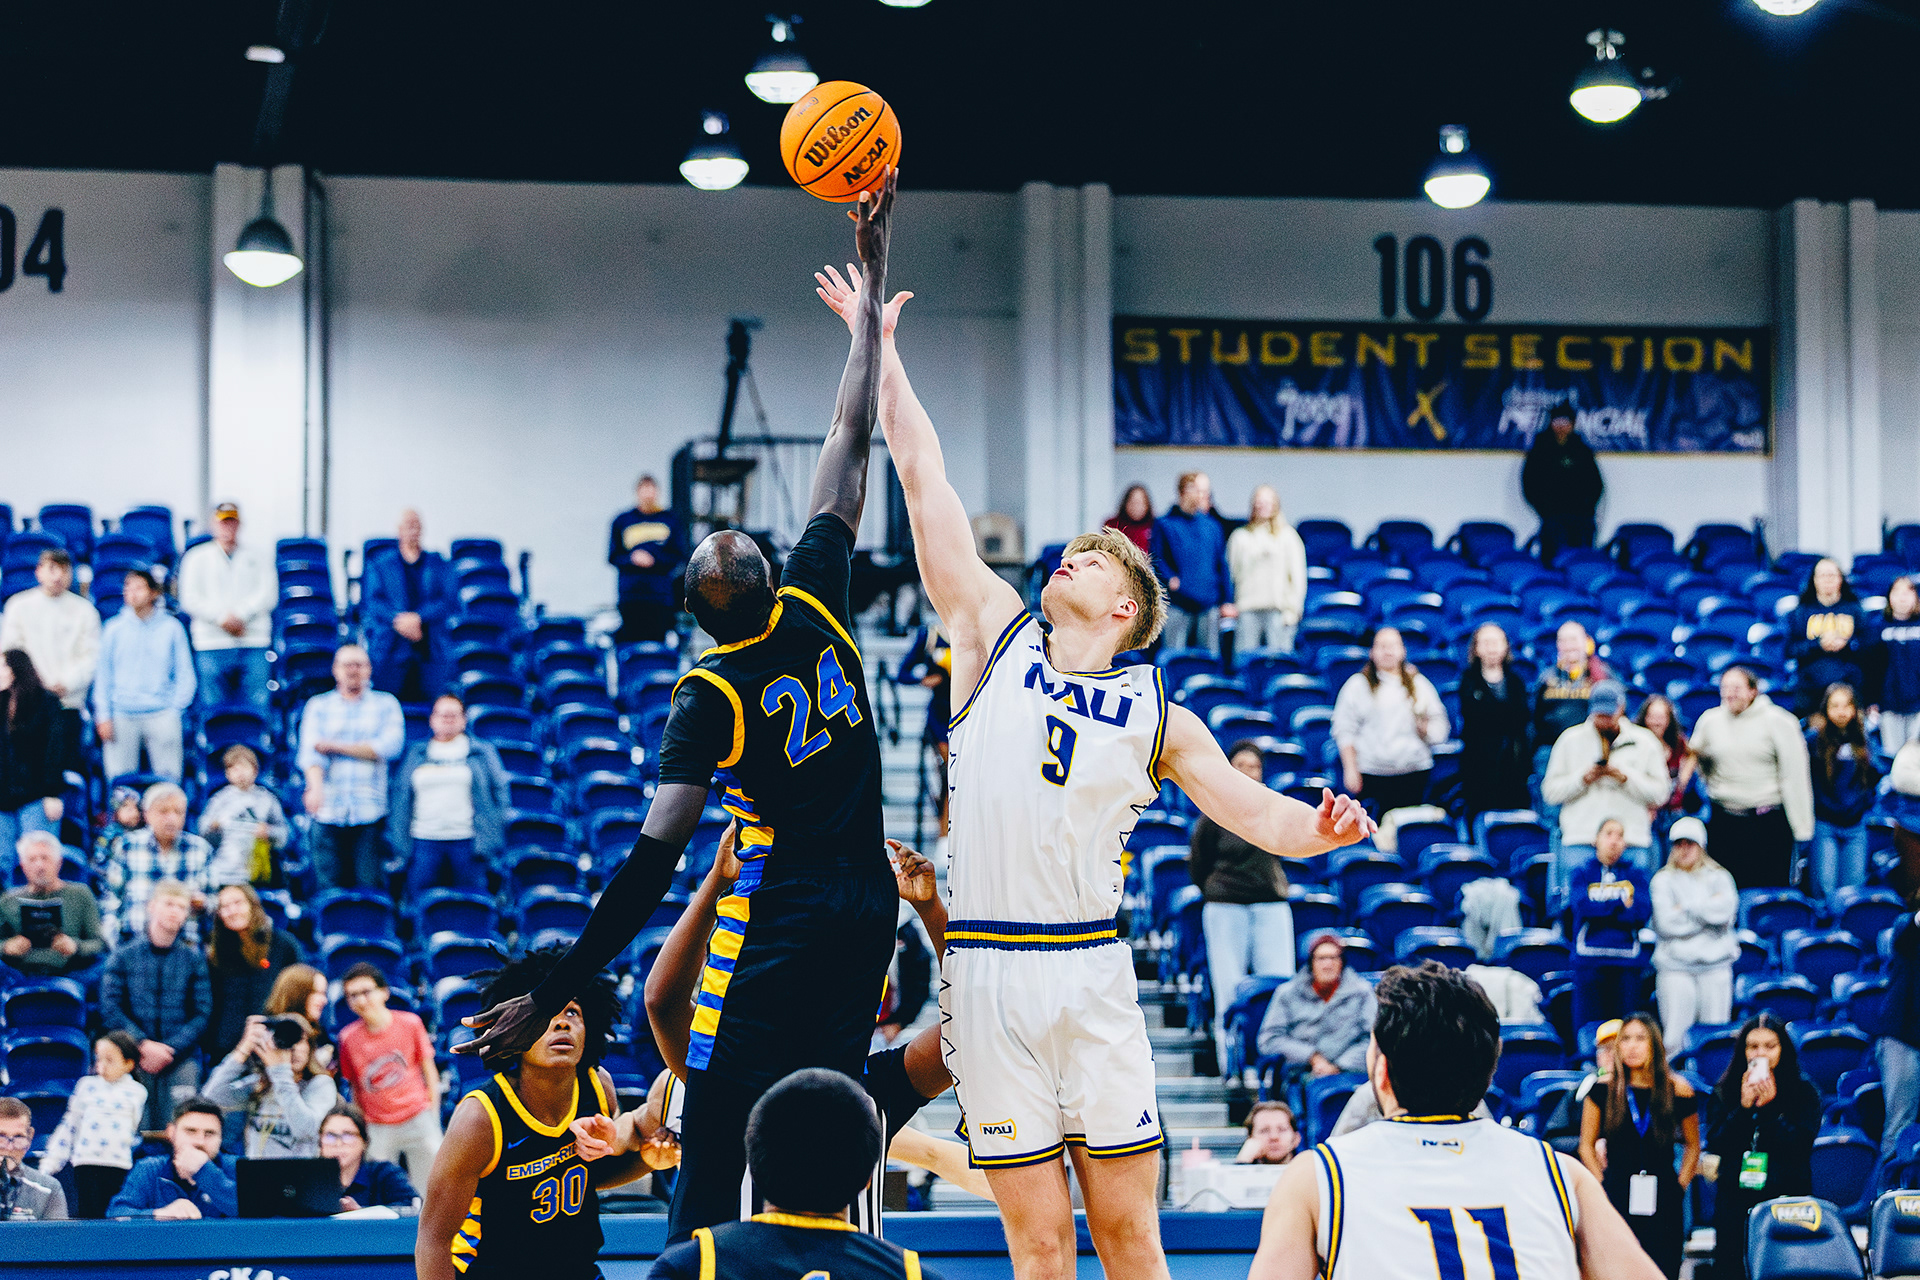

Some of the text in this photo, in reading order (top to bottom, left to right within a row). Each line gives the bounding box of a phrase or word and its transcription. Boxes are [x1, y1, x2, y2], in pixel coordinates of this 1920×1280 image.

[804, 106, 872, 167] Wilson
[843, 135, 888, 185] NCAA
[1373, 233, 1492, 321] 106
[1122, 328, 1752, 373] STUDENT SECTION
[760, 644, 863, 768] 24
[1023, 662, 1133, 728] NAU
[1040, 713, 1079, 788] 9
[983, 1126, 1012, 1135] NAU
[530, 1163, 588, 1224] 30
[1405, 1204, 1520, 1280] 11
